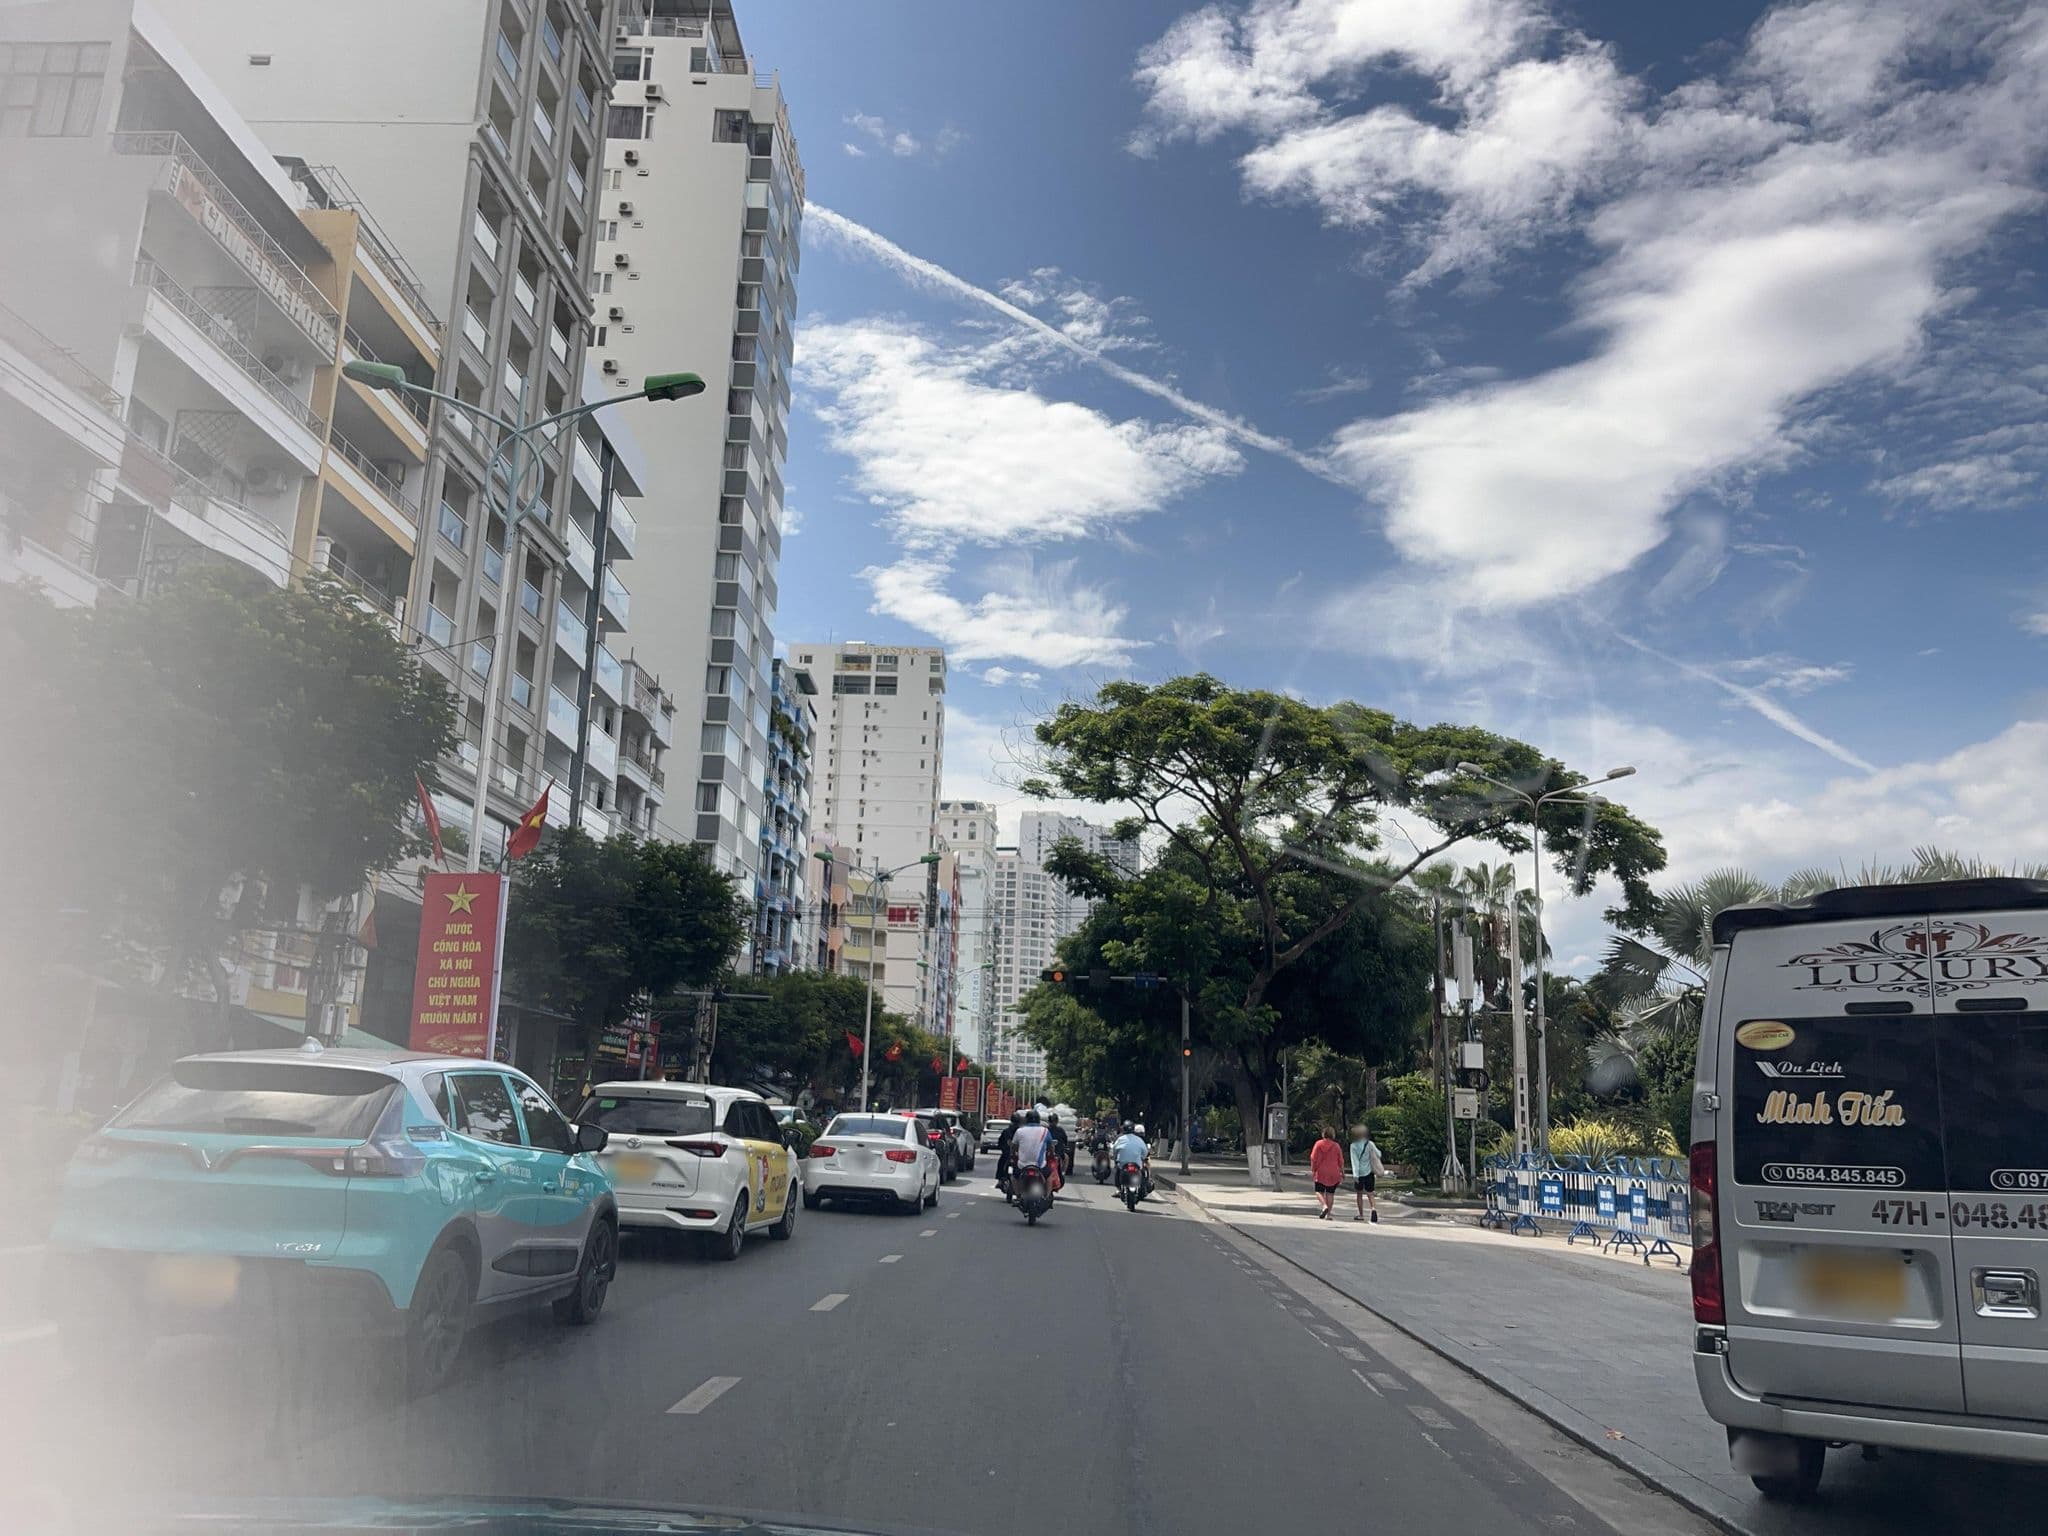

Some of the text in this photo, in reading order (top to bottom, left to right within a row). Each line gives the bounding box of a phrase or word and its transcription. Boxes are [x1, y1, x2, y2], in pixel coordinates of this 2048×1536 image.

[445, 923, 473, 935] NƯỚC
[433, 939, 459, 954] CỘNG
[455, 957, 473, 971] HỘI
[1808, 956, 2048, 986] LUXURY
[429, 994, 478, 1007] VIỆT NAM
[419, 1012, 451, 1024] MUÔN
[452, 1011, 477, 1024] NĂM
[1777, 1060, 1843, 1076] Du Lịch
[1756, 1089, 1906, 1128] Minh Tiến
[1785, 1165, 1898, 1185] 0584.845.845
[1753, 1200, 1836, 1216] TRANSIT
[1871, 1199, 1928, 1226] 47H
[1951, 1201, 2048, 1230] 048.48
